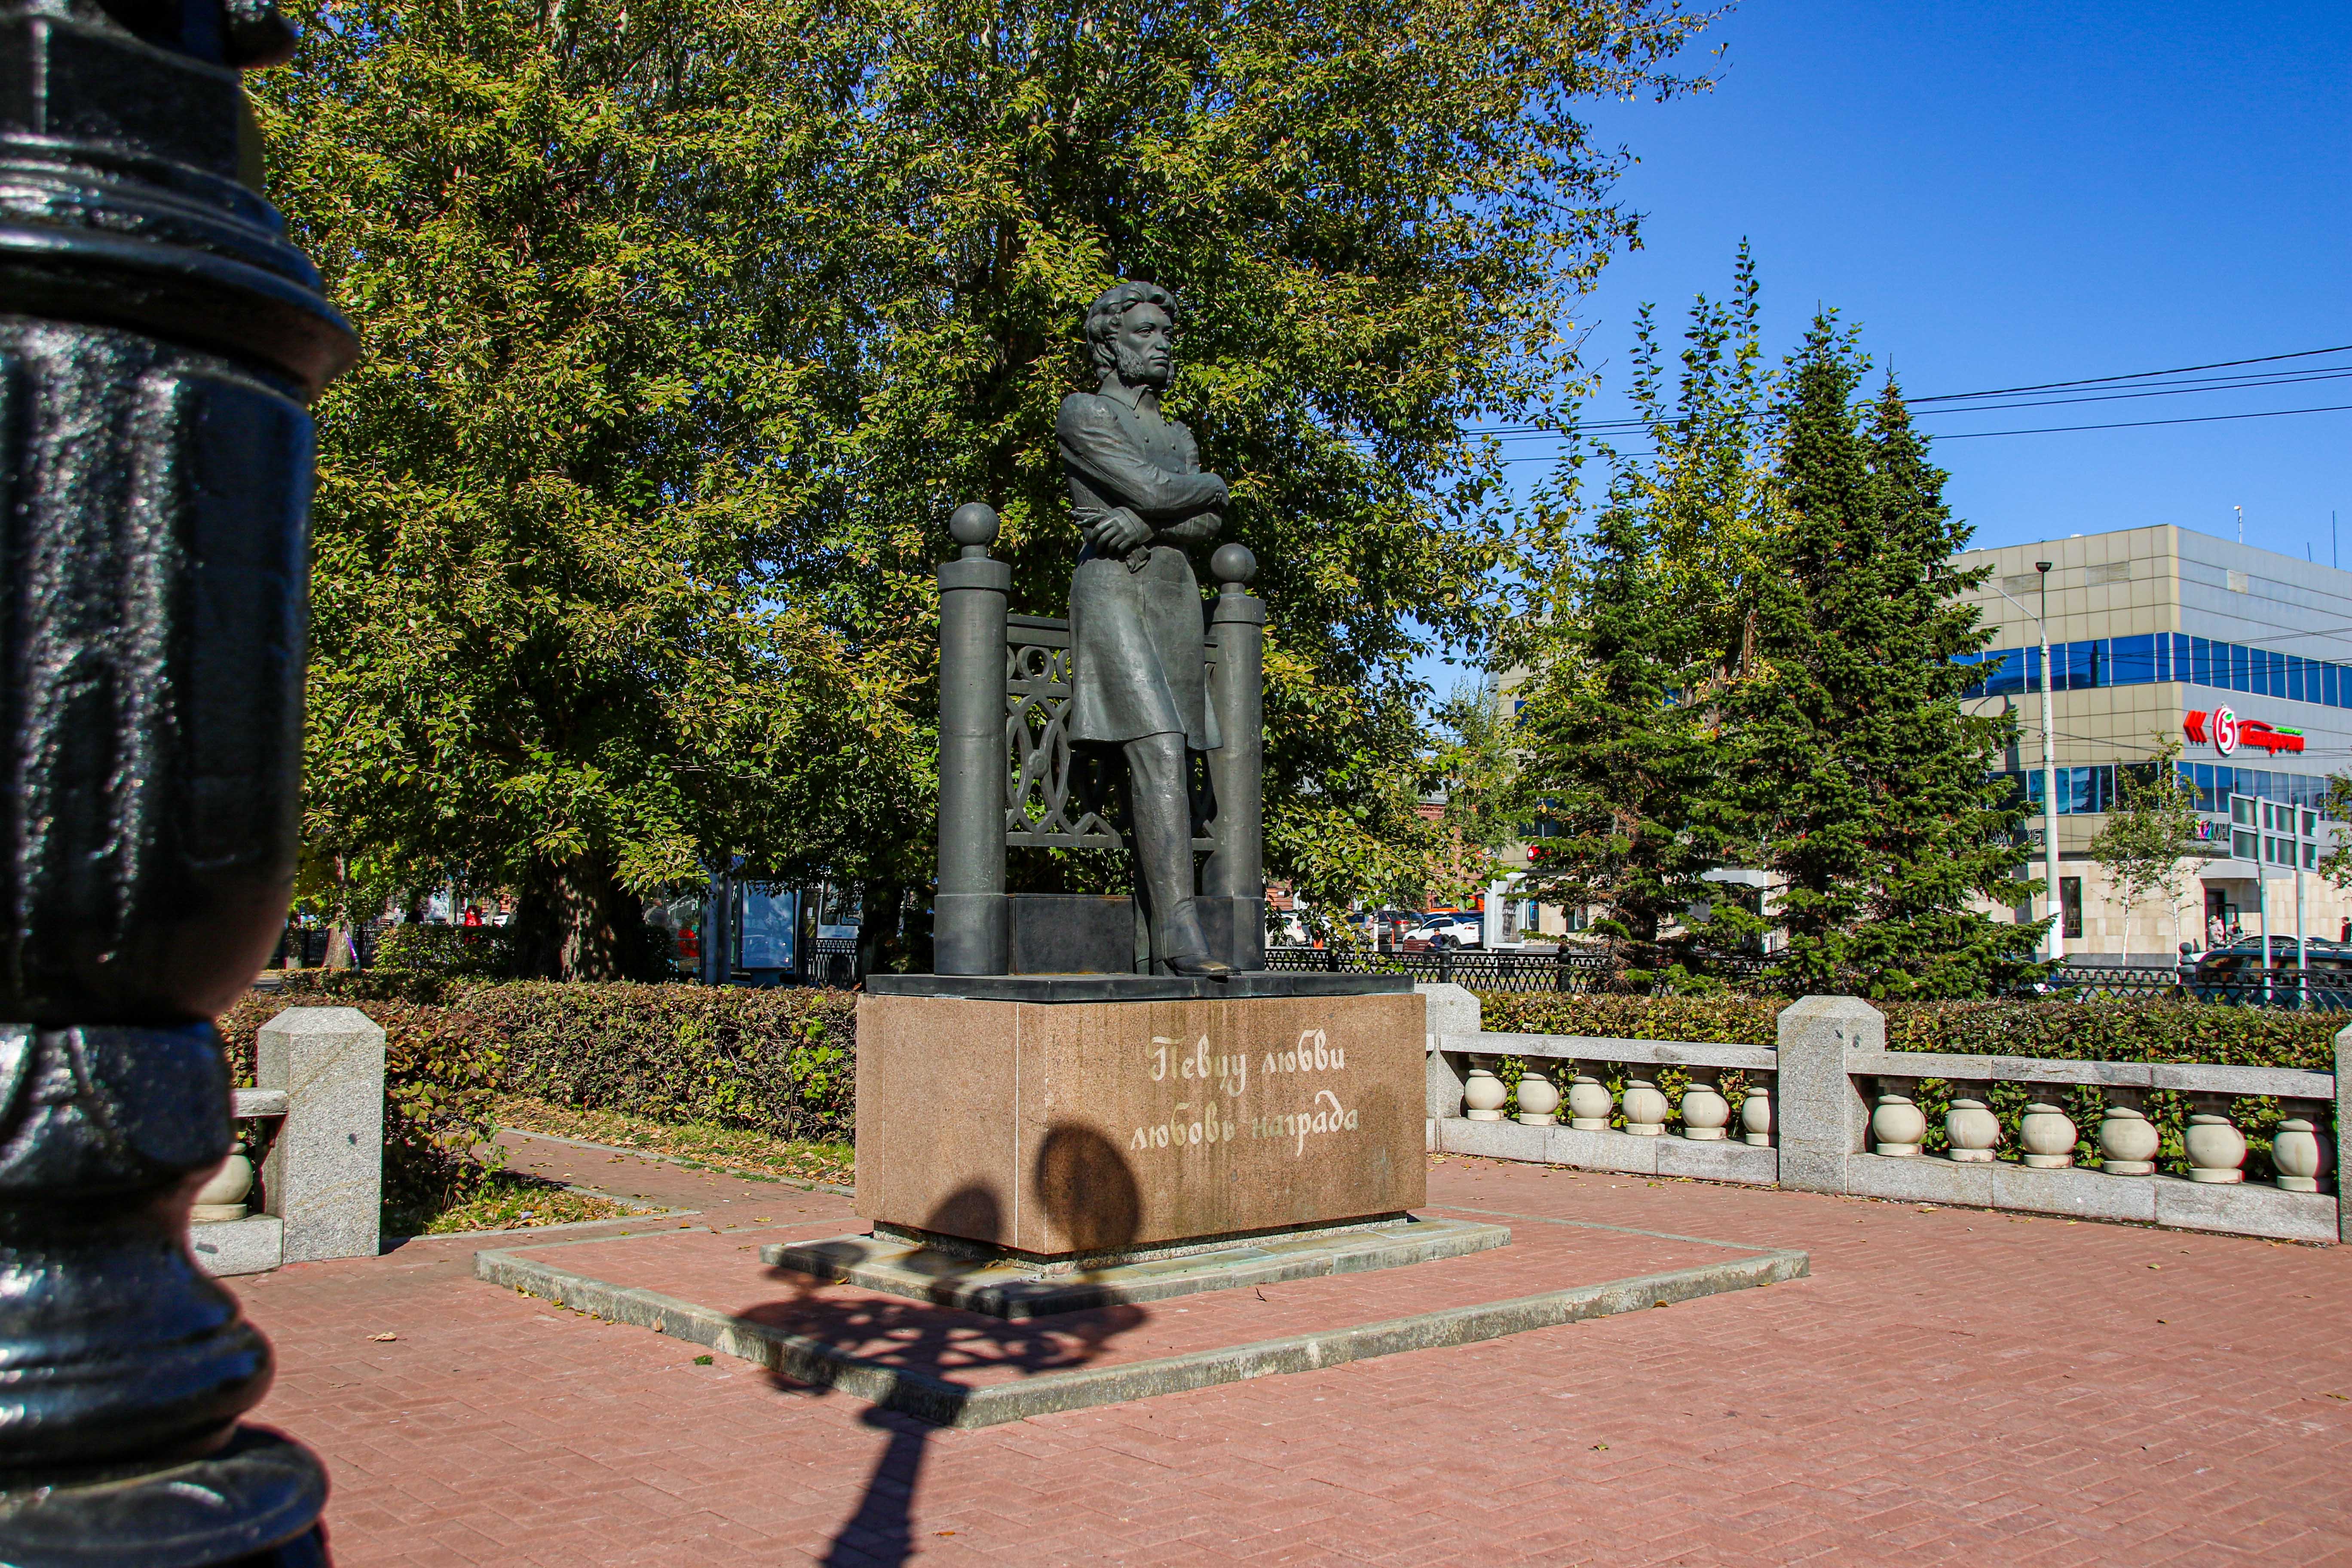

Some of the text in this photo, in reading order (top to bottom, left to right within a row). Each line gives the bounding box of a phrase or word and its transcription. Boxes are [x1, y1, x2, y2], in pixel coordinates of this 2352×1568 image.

[1145, 1028, 1345, 1097] Певцу любви
[1130, 1090, 1359, 1157] любовь награда
